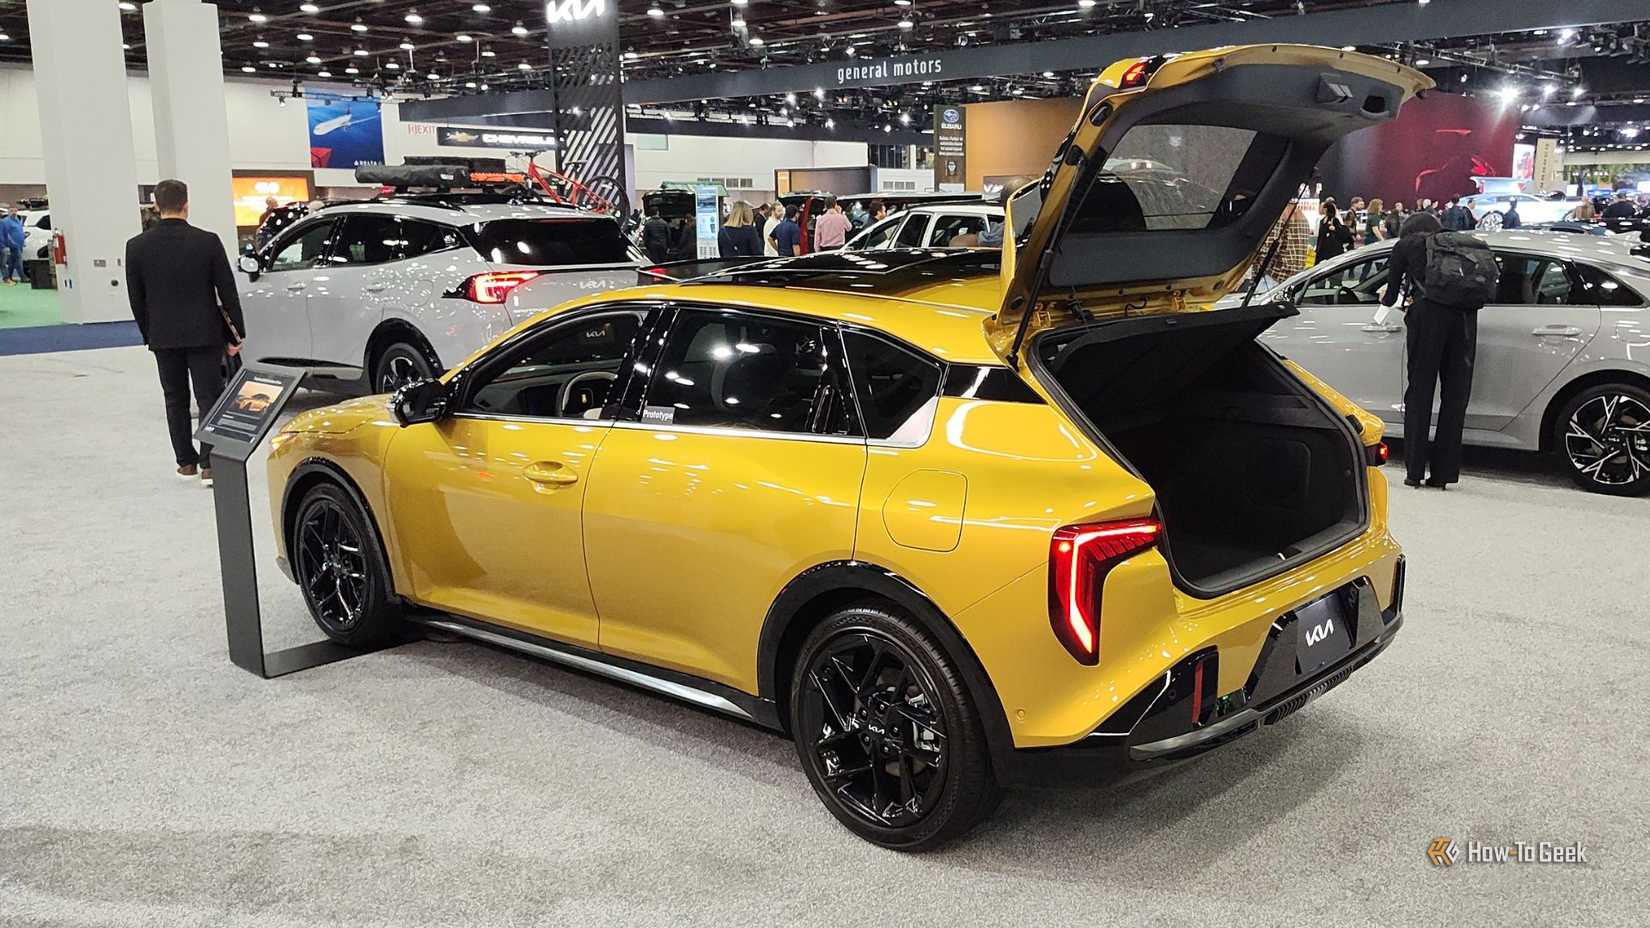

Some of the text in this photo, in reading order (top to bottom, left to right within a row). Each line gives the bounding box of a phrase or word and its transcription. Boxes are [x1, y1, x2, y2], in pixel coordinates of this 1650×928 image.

[837, 59, 942, 84] general motors
[482, 133, 556, 145] CHEVROLE
[643, 408, 674, 421] Prototype
